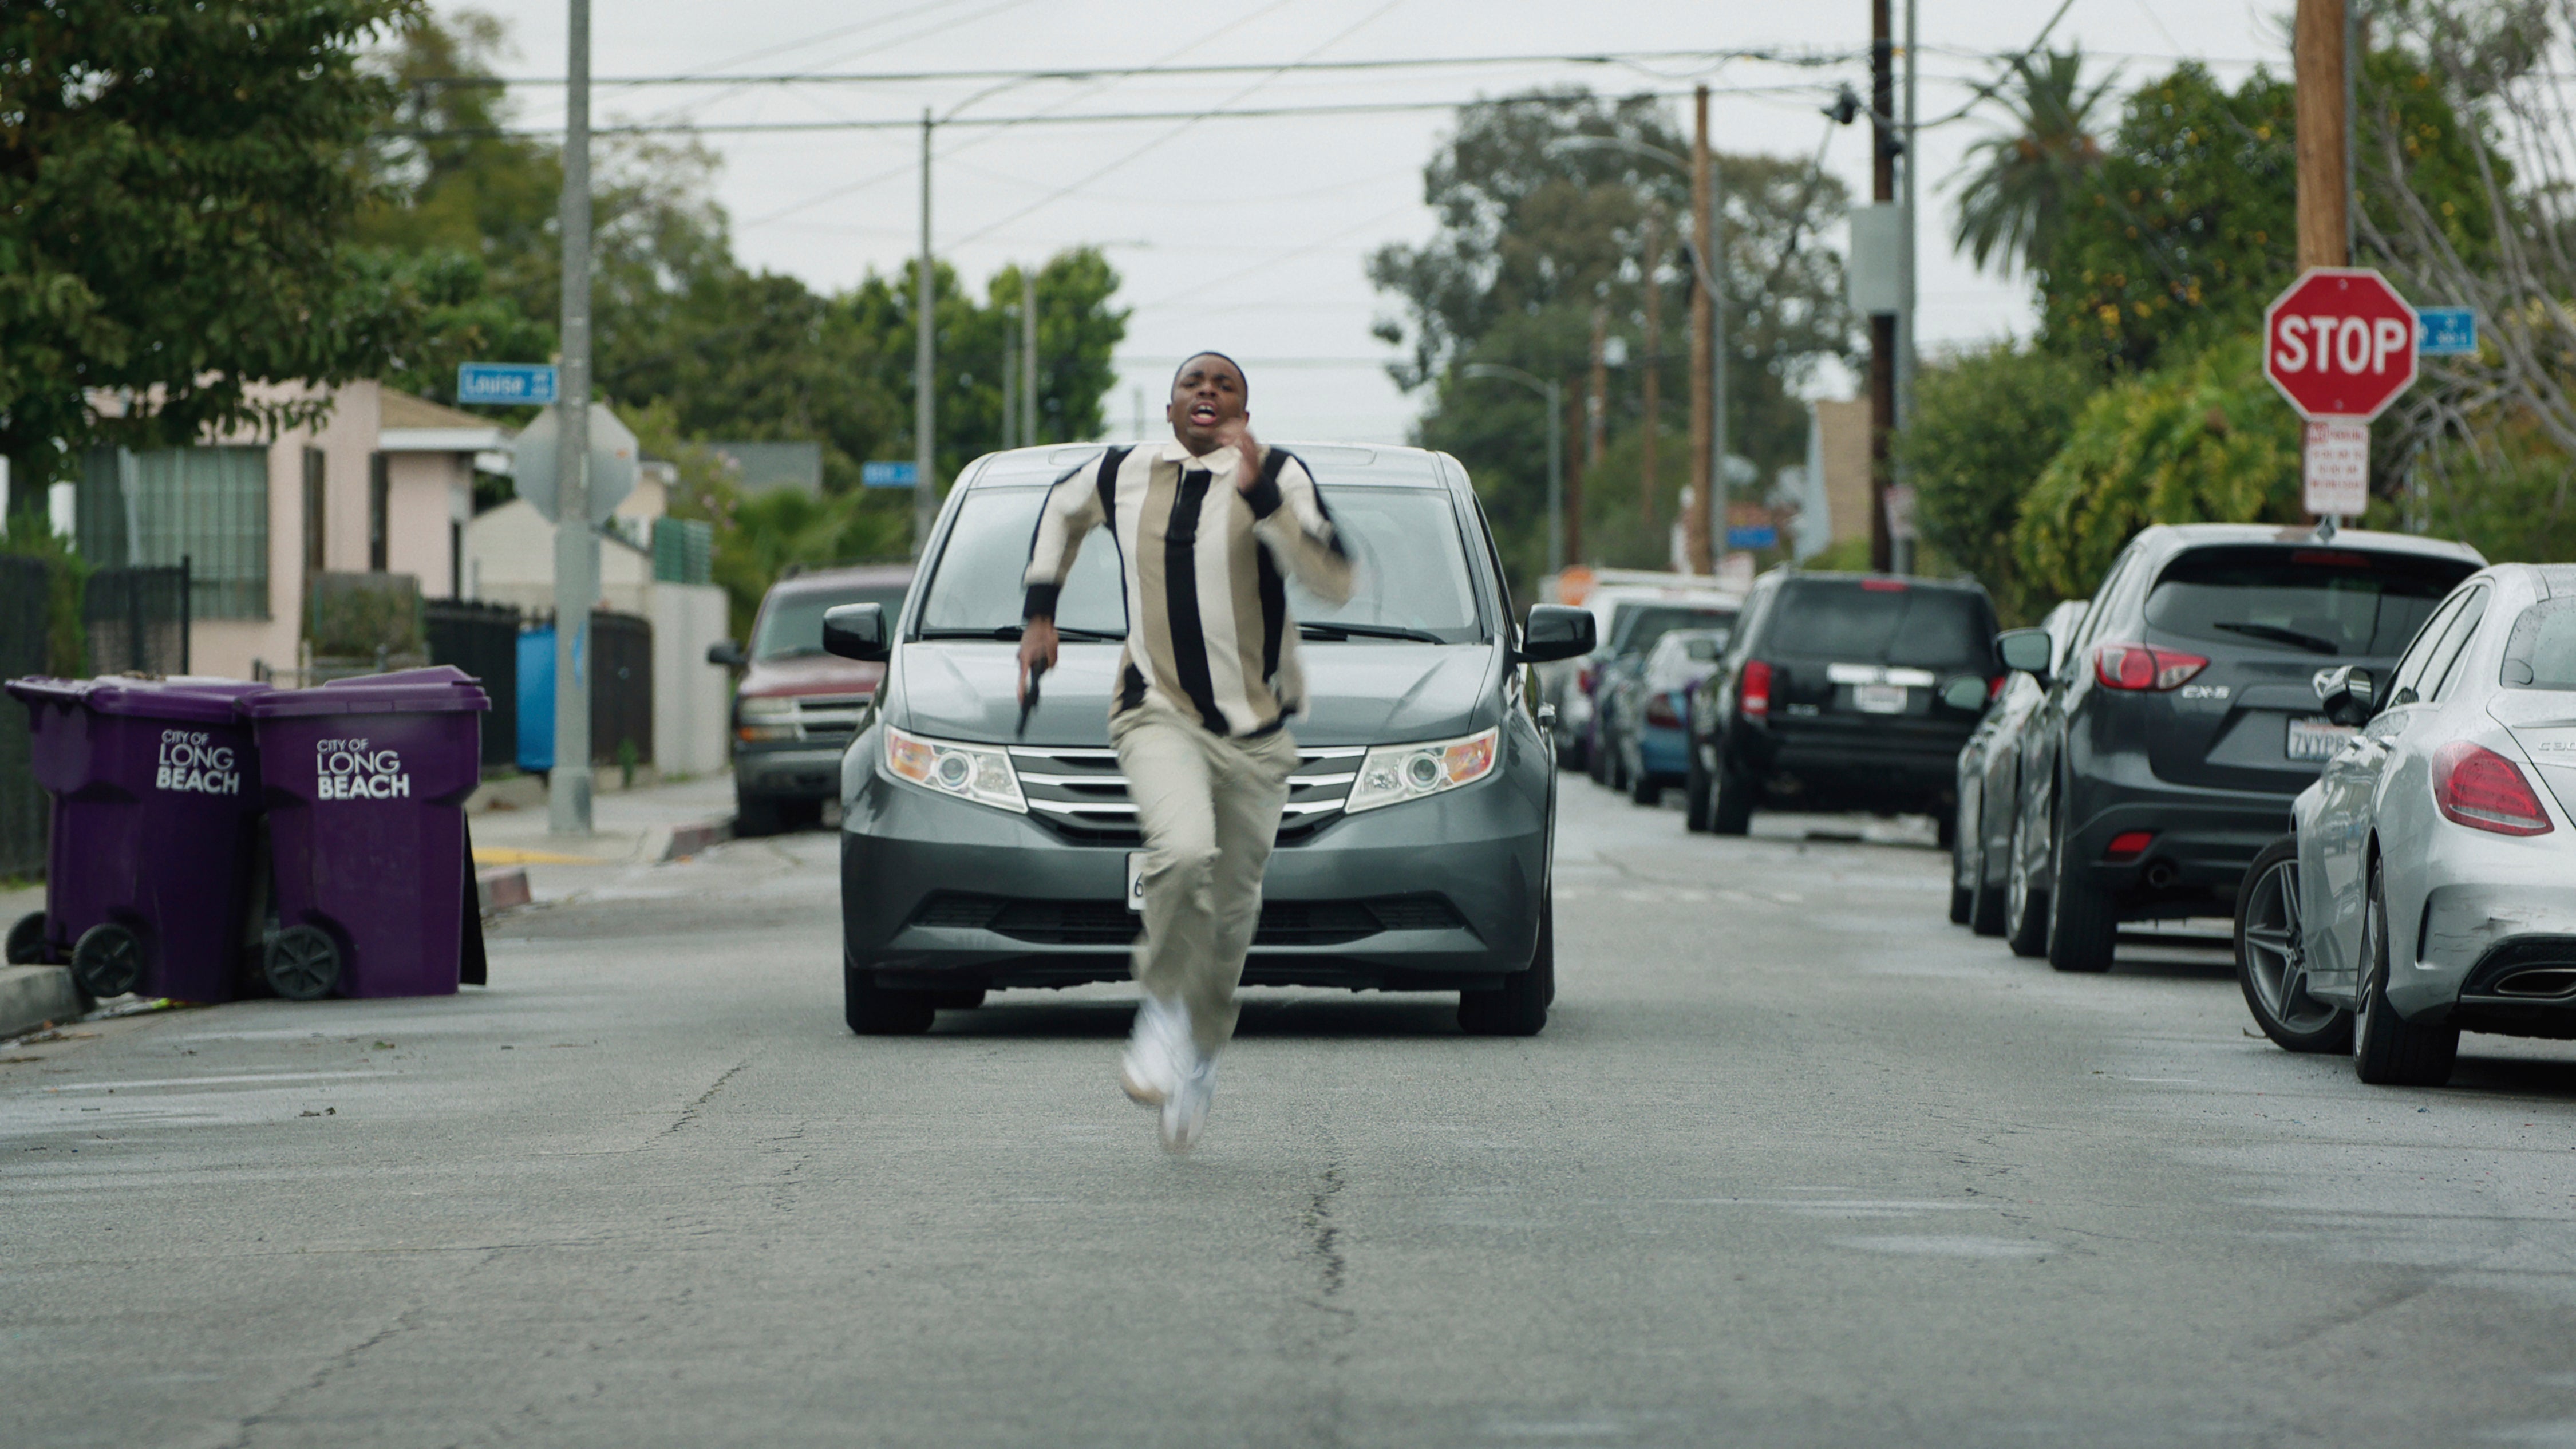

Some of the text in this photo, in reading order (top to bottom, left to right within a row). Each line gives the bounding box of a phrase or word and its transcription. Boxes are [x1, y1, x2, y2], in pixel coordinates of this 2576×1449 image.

[2275, 314, 2408, 375] STOP
[465, 373, 526, 394] Louise
[2181, 685, 2231, 699] CX-5
[161, 729, 210, 746] CITY OF
[317, 737, 369, 753] CITY OF
[159, 743, 235, 771] LONG
[317, 749, 401, 776] LONG
[156, 766, 241, 796] BEACH
[318, 773, 410, 800] BEACH
